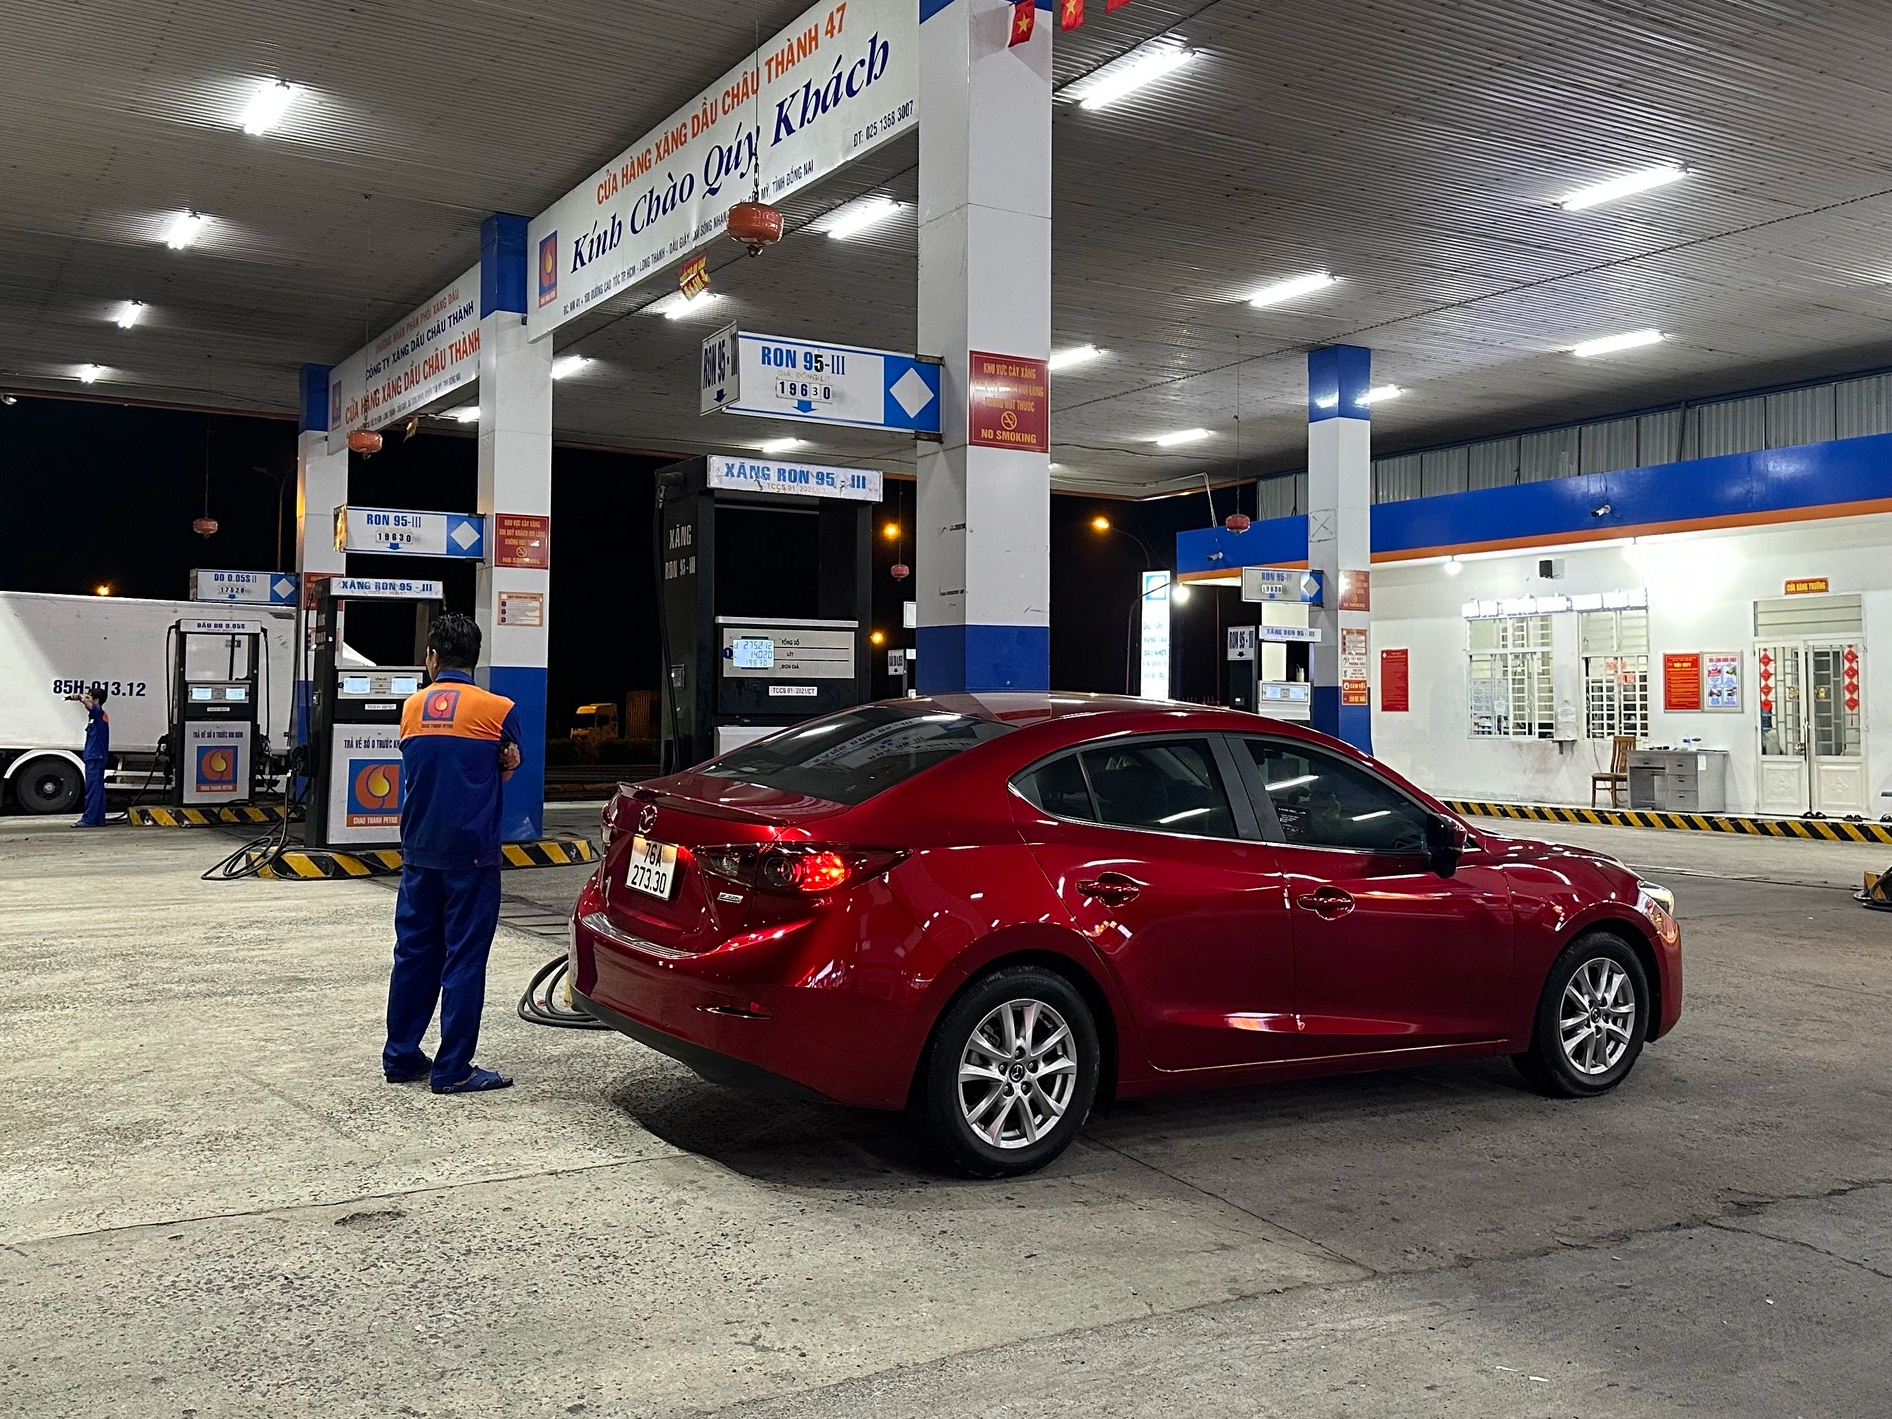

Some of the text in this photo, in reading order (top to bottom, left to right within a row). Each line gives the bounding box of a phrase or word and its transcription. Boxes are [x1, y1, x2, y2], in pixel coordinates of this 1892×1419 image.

[597, 2, 847, 205] CỬA HÀNG XĂNG DẦU CHÂU THÀNH 47
[854, 130, 864, 148] ĐT:
[866, 122, 878, 140] 025
[898, 100, 914, 122] 3007
[570, 31, 890, 274] Kính Chào Quý Khách
[604, 279, 612, 293] CAO
[640, 256, 651, 272] LONG
[651, 247, 666, 264] THÀNH
[700, 219, 713, 237] SÔNG
[787, 165, 802, 187] ĐỒNG
[803, 159, 814, 175] NAI
[432, 297, 448, 315] XĂNG
[448, 286, 460, 306] DẦU
[366, 300, 474, 381] CÔNG TY XĂNG DẦU CHÂU THÀNH
[703, 332, 738, 390] RON 95 III
[762, 346, 846, 375] RON 95-III
[983, 362, 1037, 380] KHU VỰC CÂY XĂNG
[345, 397, 358, 425] CỬA
[361, 389, 380, 414] HÀNG
[382, 375, 402, 403] XĂNG
[404, 360, 420, 392] DẦU
[423, 347, 446, 380] CHÂU
[449, 328, 480, 366] THÀNH
[780, 381, 831, 400] 19630
[1017, 398, 1035, 413] THUỐC
[981, 429, 1037, 444] NO SMOKING
[725, 461, 867, 490] XĂNG RON 95 III
[367, 514, 390, 526] RON
[378, 533, 412, 543] 19630
[669, 524, 692, 550] XĂNG
[214, 574, 225, 582] DO
[665, 560, 678, 580] RON
[1262, 572, 1275, 581] RON
[341, 580, 433, 592] XĂNG RON 95 III
[1229, 631, 1239, 650] RON
[1239, 631, 1246, 649] 95
[53, 680, 147, 697] 85H-013.12
[344, 736, 354, 749] TRẢ
[644, 843, 663, 868] 76A
[631, 865, 667, 894] 273.30
